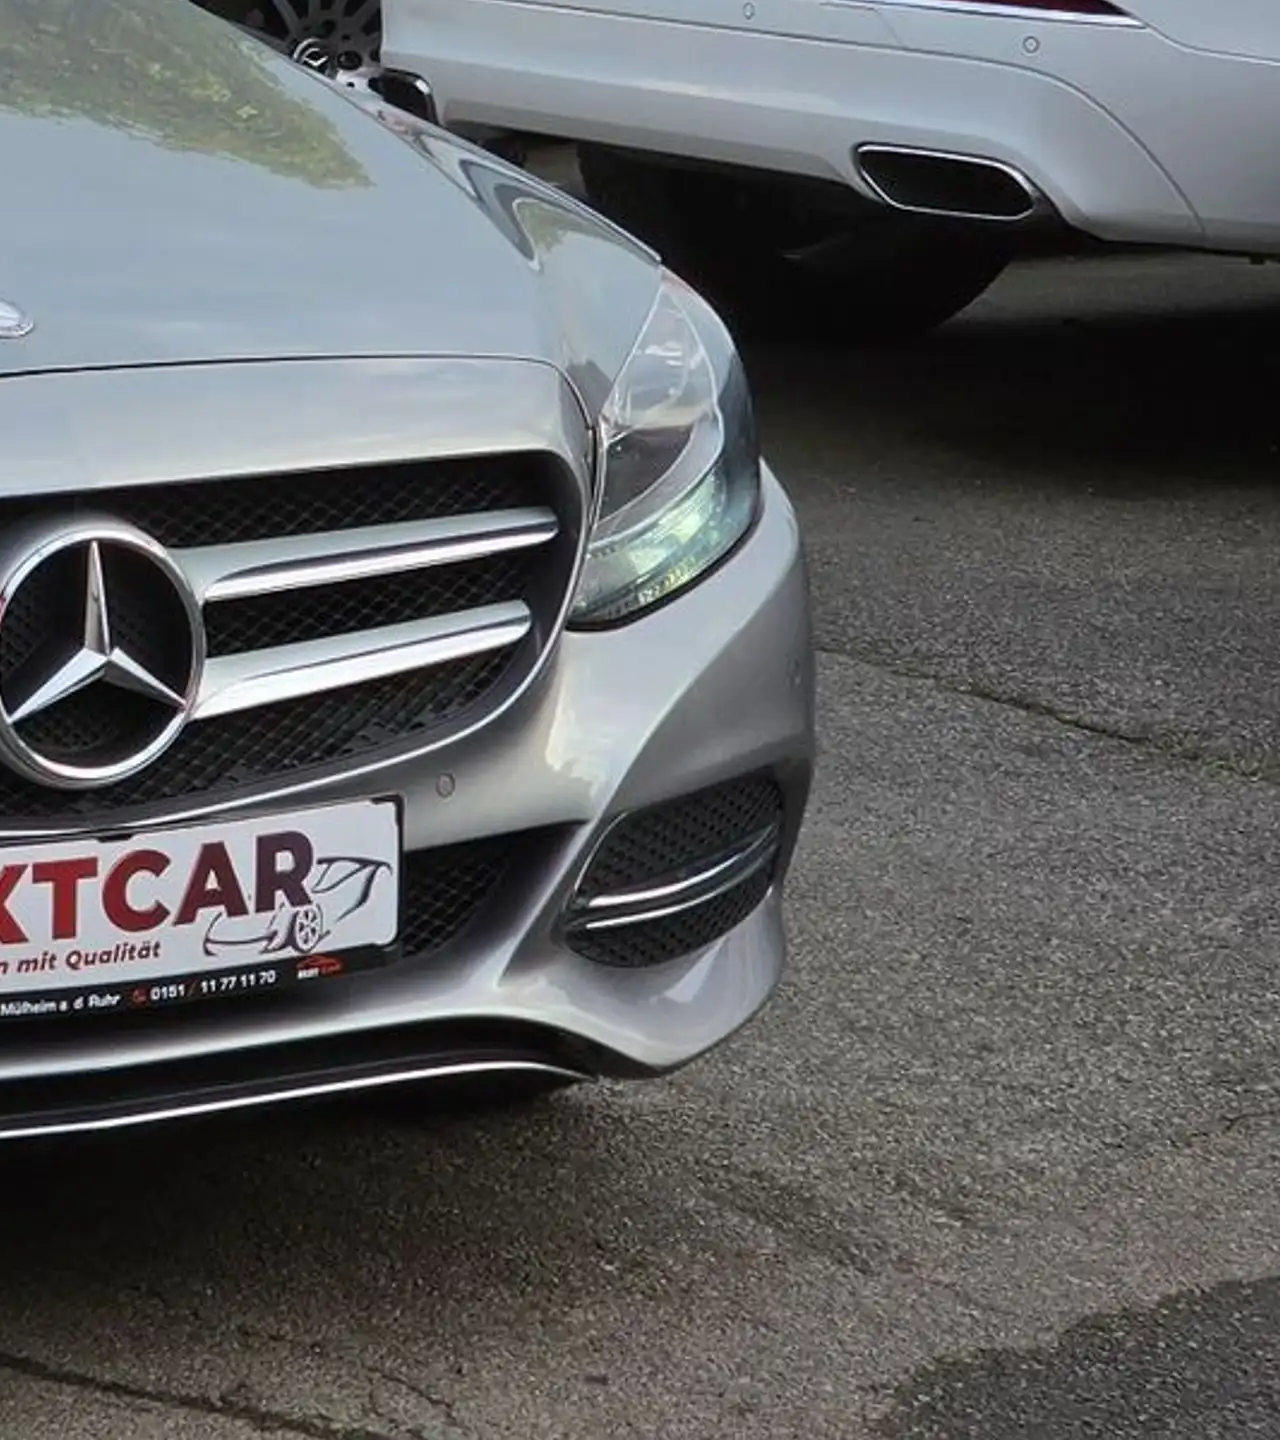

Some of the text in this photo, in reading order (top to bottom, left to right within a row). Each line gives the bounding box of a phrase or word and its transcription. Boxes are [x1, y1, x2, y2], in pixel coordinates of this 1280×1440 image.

[16, 950, 57, 974] mit
[65, 939, 162, 971] Qualität
[87, 992, 121, 1009] Ruhr
[150, 983, 186, 1001] 0151
